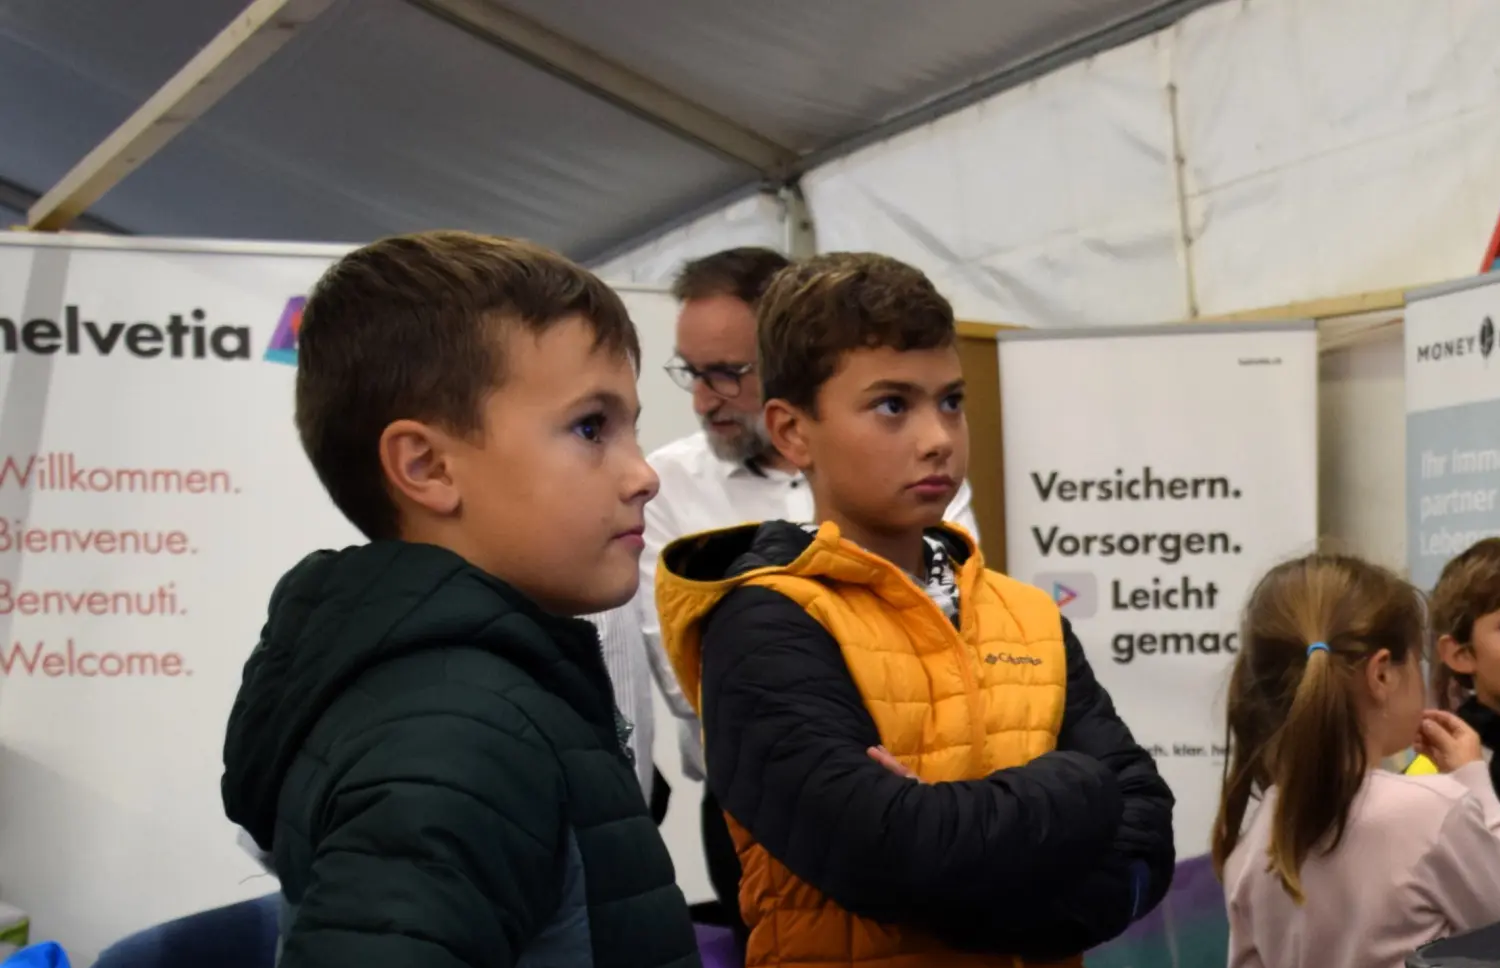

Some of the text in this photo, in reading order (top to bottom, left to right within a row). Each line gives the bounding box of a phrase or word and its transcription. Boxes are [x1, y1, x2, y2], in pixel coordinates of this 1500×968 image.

[1416, 335, 1476, 363] MONEY
[0, 452, 241, 494] Willkommen.
[1421, 450, 1448, 480] Ihr
[1030, 466, 1243, 502] Versichern.
[1419, 487, 1498, 525] partner
[1031, 526, 1243, 565] Vorsorgen.
[1111, 575, 1219, 611] Leicht
[0, 637, 194, 678] Welcome.
[1111, 632, 1240, 665] gemac
